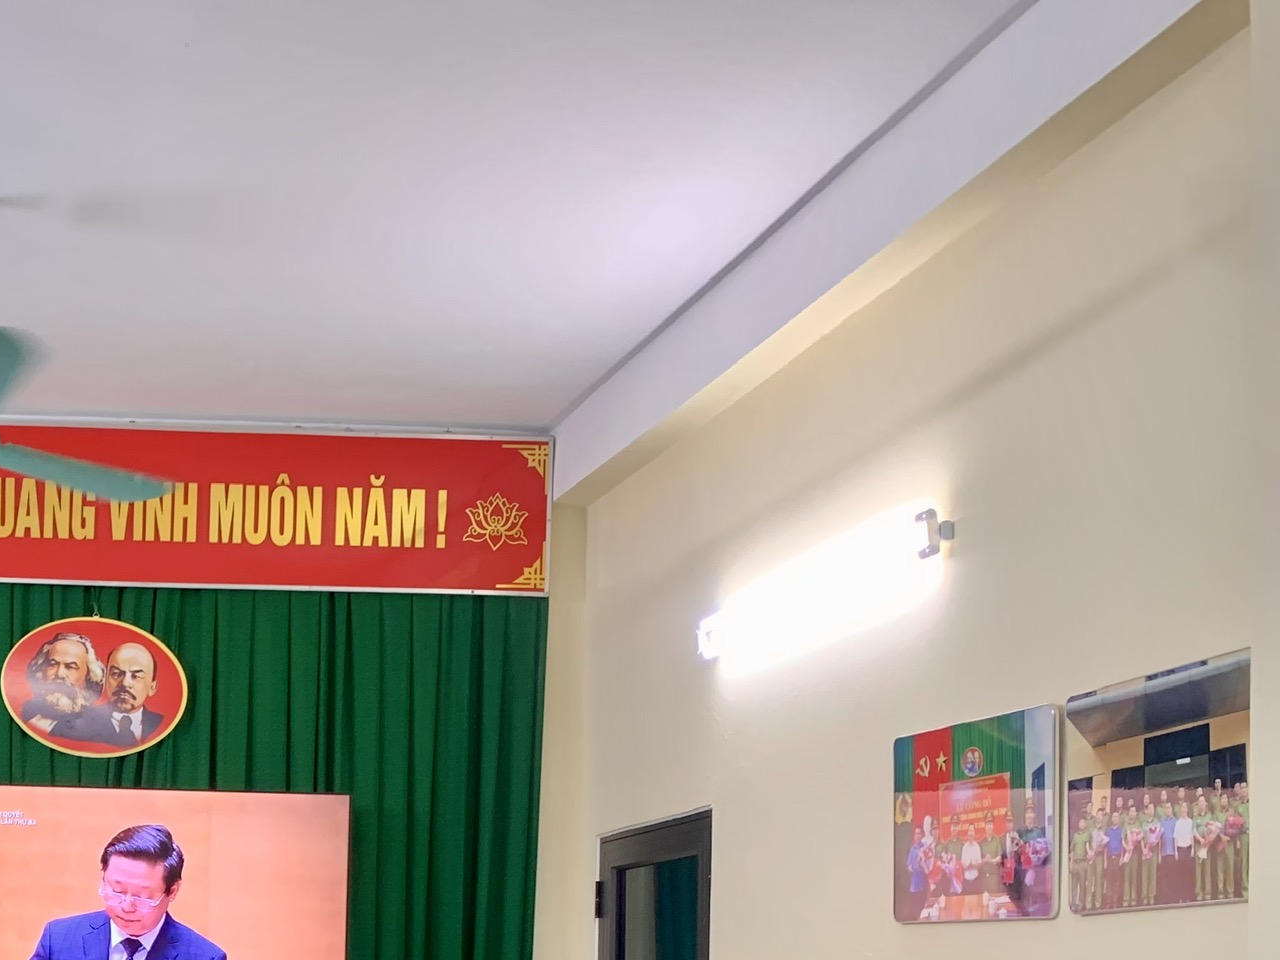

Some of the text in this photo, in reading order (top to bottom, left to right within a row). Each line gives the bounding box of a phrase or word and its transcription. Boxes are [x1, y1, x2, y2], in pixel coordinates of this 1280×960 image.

[109, 481, 199, 543] VINH
[208, 472, 324, 547] MUÔN
[334, 473, 427, 549] NĂM
[435, 488, 449, 549] !
